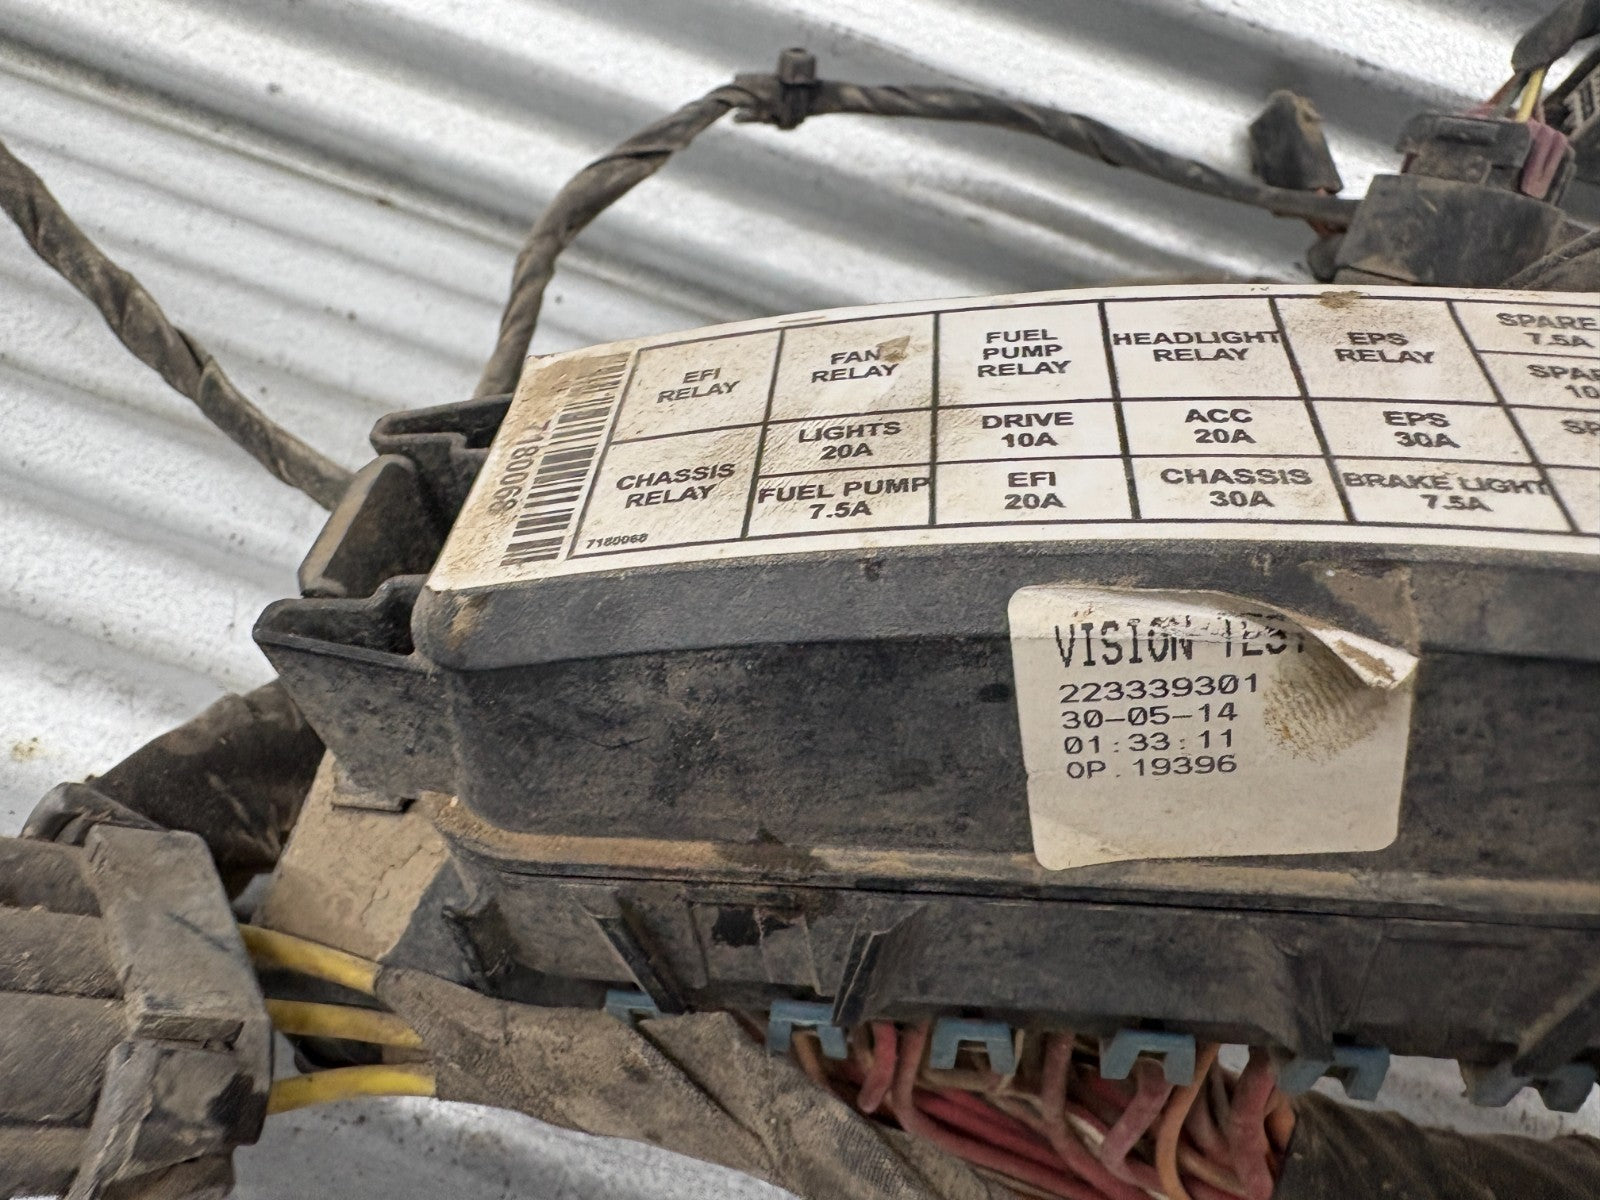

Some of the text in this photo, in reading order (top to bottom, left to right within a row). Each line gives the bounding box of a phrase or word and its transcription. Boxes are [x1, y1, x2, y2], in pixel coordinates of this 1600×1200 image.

[1497, 313, 1600, 329] SPARE
[986, 328, 1058, 343] FUEL
[1112, 330, 1280, 345] HEADLIGHT
[1348, 332, 1408, 344] EPS
[830, 345, 881, 365] FAN
[982, 344, 1063, 358] PUMP
[1153, 347, 1250, 361] RELAY
[1336, 349, 1435, 362] RELAY
[683, 367, 721, 384] EFI
[811, 363, 899, 384] RELAY
[977, 360, 1072, 376] RELAY
[1527, 365, 1600, 379] SPAR
[657, 380, 741, 404] RELAY
[1565, 385, 1600, 397] 10
[981, 412, 1075, 427] DRIVE
[1185, 408, 1253, 422] ACC
[1384, 411, 1451, 426] EPS
[799, 421, 902, 443] LIGHTS
[1001, 431, 1058, 446] 10A
[1194, 428, 1257, 442] 20A
[1395, 431, 1461, 447] 30A
[819, 442, 874, 461] 20A
[616, 463, 736, 491] CHASSIS
[1007, 471, 1057, 486] EFI
[1160, 468, 1313, 483] CHASSIS
[1343, 473, 1550, 493] BRAKE LIGHT
[625, 484, 717, 509] RELAY
[757, 477, 931, 504] FUEL PUMP
[1209, 490, 1275, 506] 30A
[1004, 493, 1066, 508] 20A
[809, 500, 873, 520] 7.5A
[1055, 615, 1193, 667] VISION
[1059, 674, 1257, 703] 223339301
[1062, 702, 1238, 729] 30-05-14
